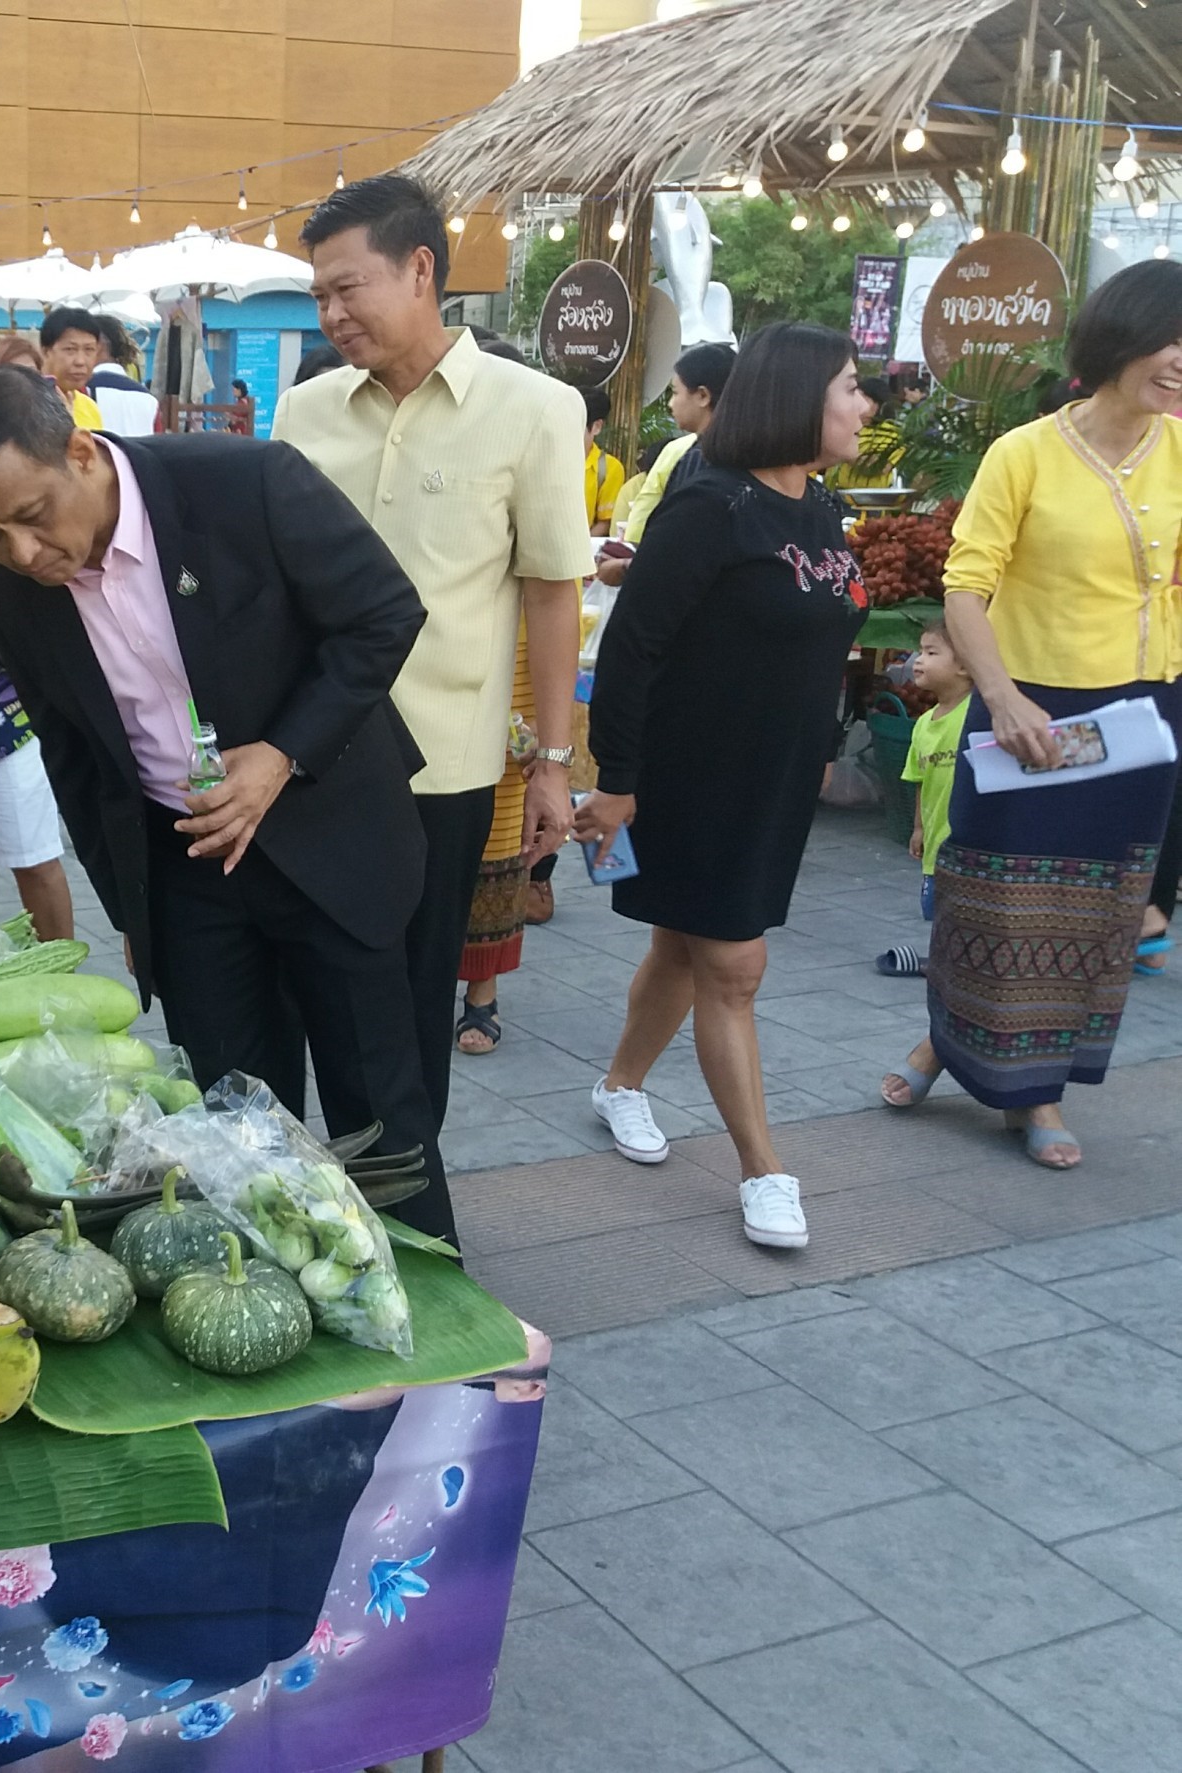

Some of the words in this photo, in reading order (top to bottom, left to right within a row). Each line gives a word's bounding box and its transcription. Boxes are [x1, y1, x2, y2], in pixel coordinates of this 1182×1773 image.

[956, 262, 991, 282] หมู่บ้าน
[560, 283, 583, 299] หมู่บ้าน
[941, 280, 1052, 327] หนองเสม็ด
[557, 299, 614, 332] สองสลึง
